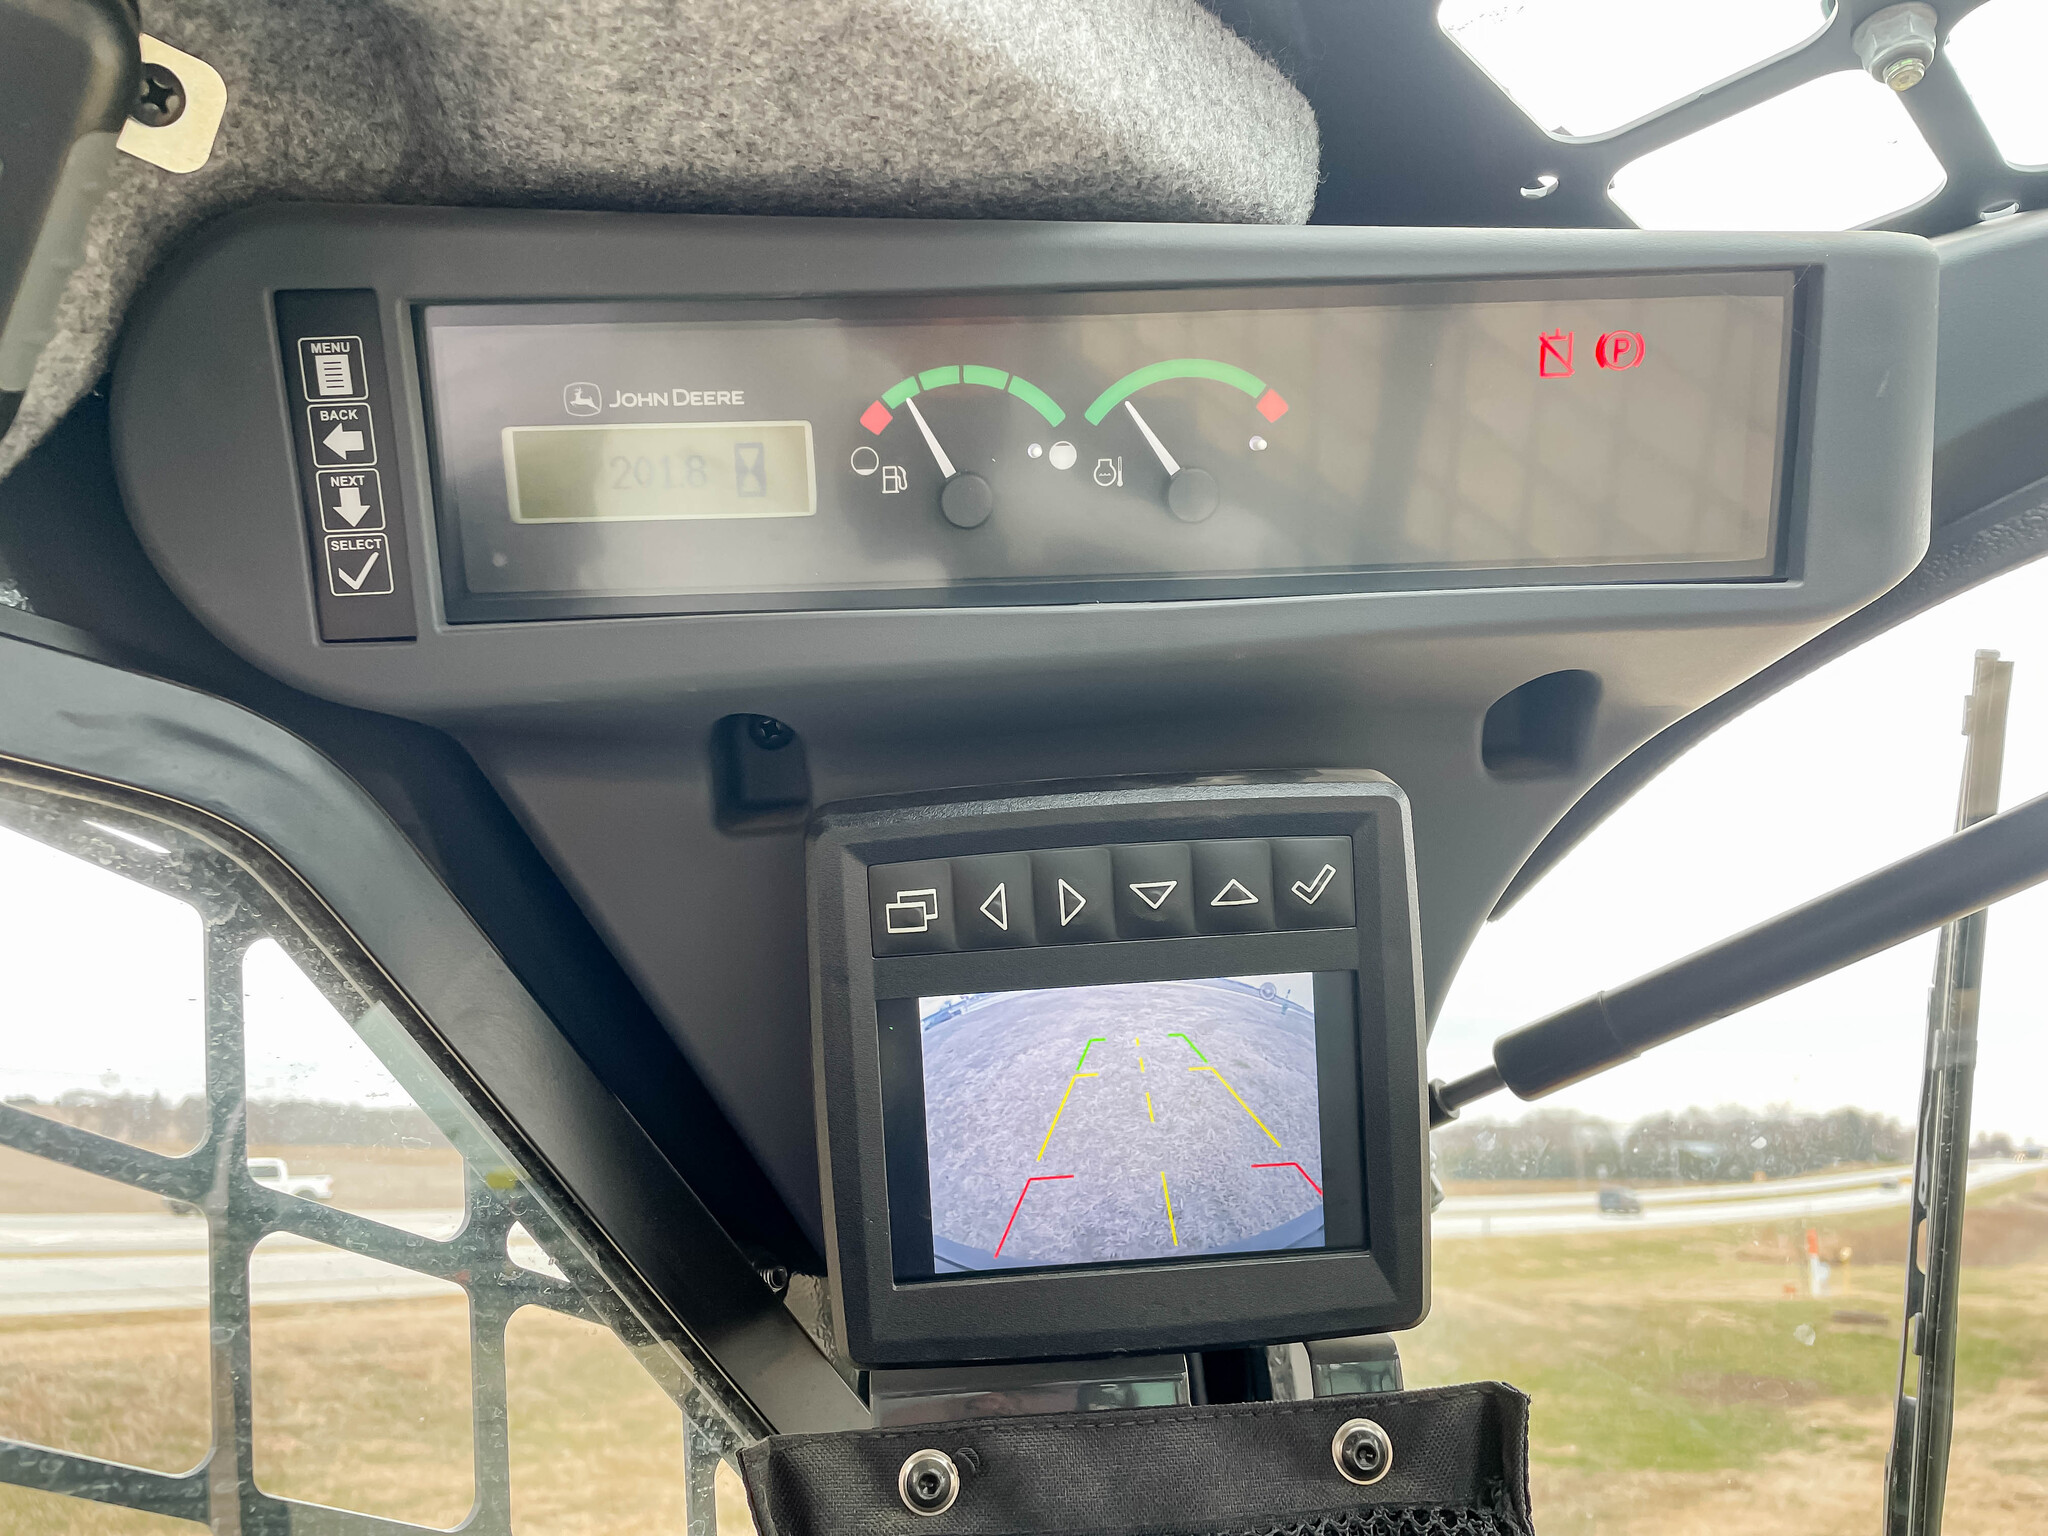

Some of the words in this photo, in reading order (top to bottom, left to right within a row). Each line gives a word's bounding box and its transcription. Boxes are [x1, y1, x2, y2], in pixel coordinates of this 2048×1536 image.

[310, 342, 350, 354] MENU
[1613, 338, 1631, 364] P
[609, 390, 669, 408] JOHN
[671, 388, 745, 406] DEERE
[320, 410, 359, 421] BACK
[330, 475, 365, 487] NEXT
[331, 539, 382, 551] SELECT
